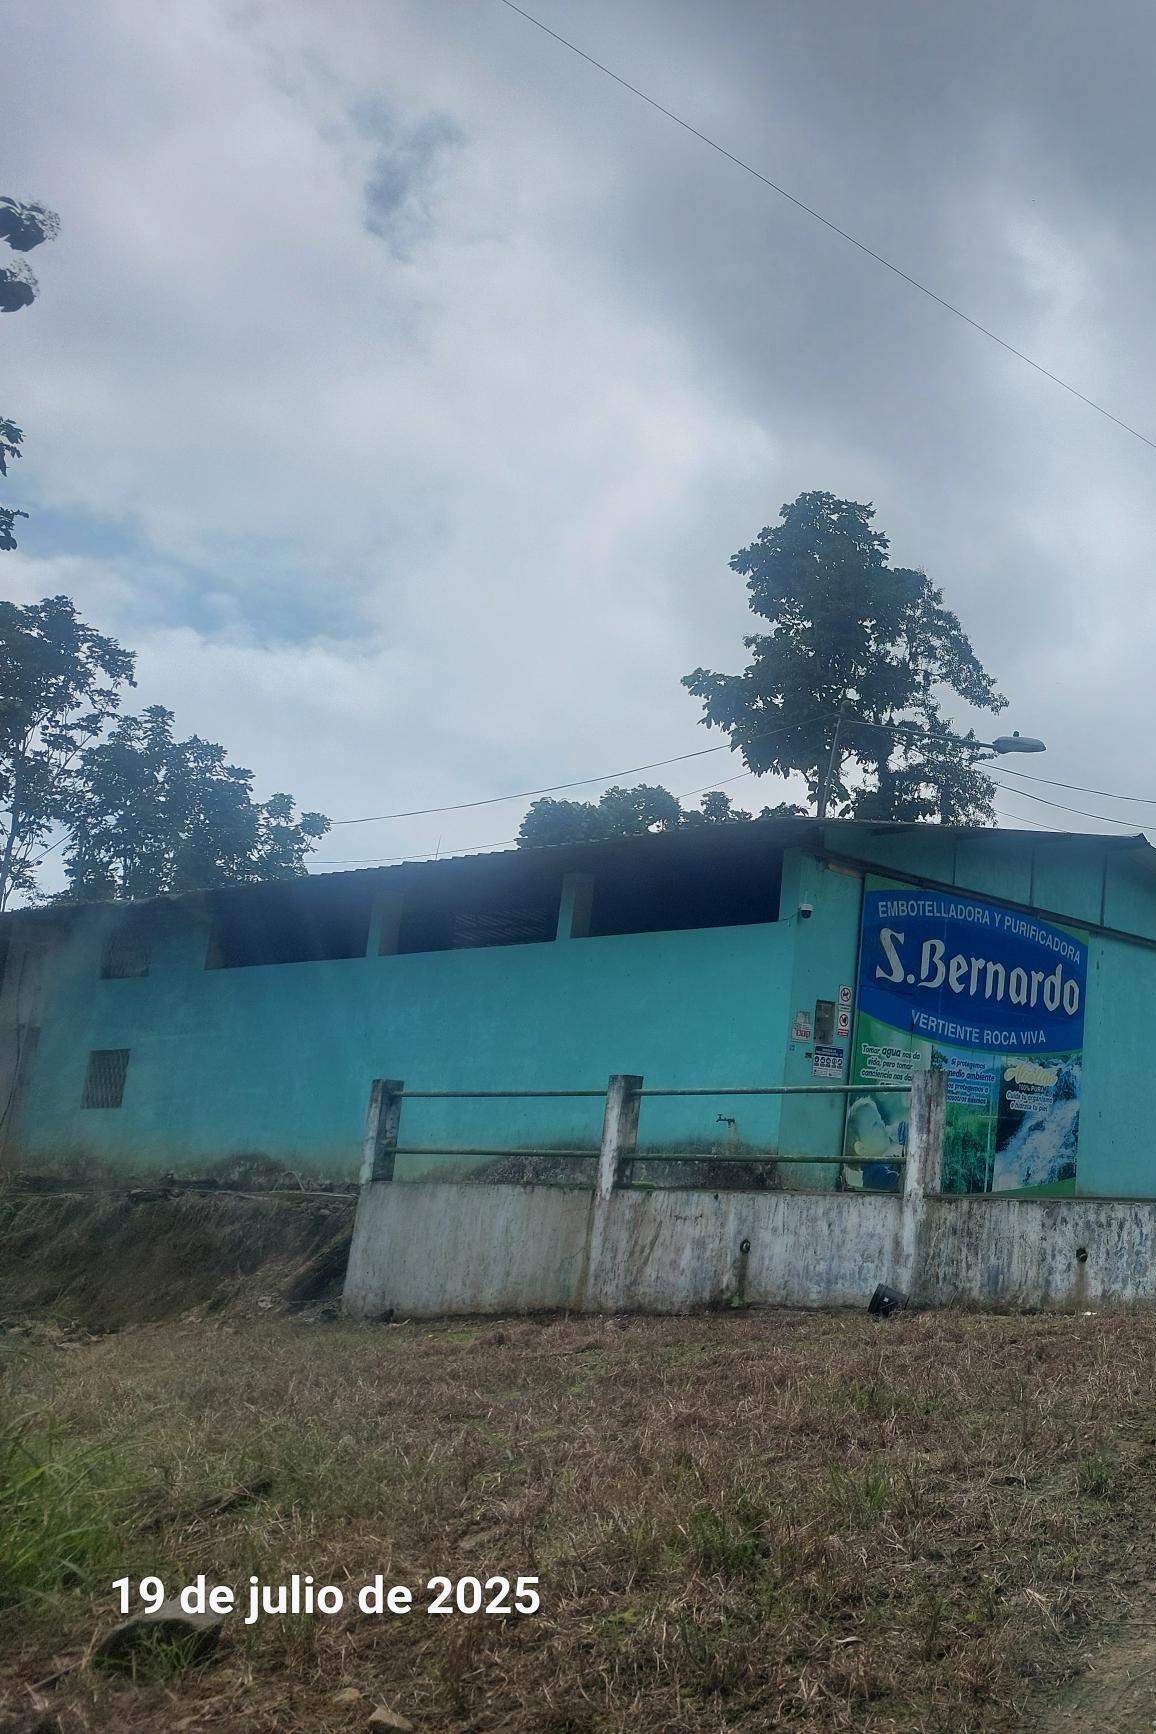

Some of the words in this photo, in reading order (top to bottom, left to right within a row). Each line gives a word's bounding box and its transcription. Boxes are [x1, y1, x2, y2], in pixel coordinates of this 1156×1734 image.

[878, 900, 991, 925] EMBOTELLADORA
[994, 913, 1002, 928] Y
[1004, 917, 1081, 965] PURIFICADORA
[911, 1009, 980, 1043] VERTIENTE
[983, 1030, 1018, 1045] ROCA
[1020, 1030, 1046, 1045] VIVA
[862, 1044, 880, 1054] Tomar
[881, 1047, 901, 1058] agua
[902, 1051, 911, 1059] nos
[883, 1060, 895, 1069] pero
[896, 1062, 913, 1070] tomar
[861, 1069, 892, 1079] conciencia
[893, 1073, 903, 1081] nos
[966, 1071, 995, 1082] ambiente
[954, 1083, 984, 1092] protegemos
